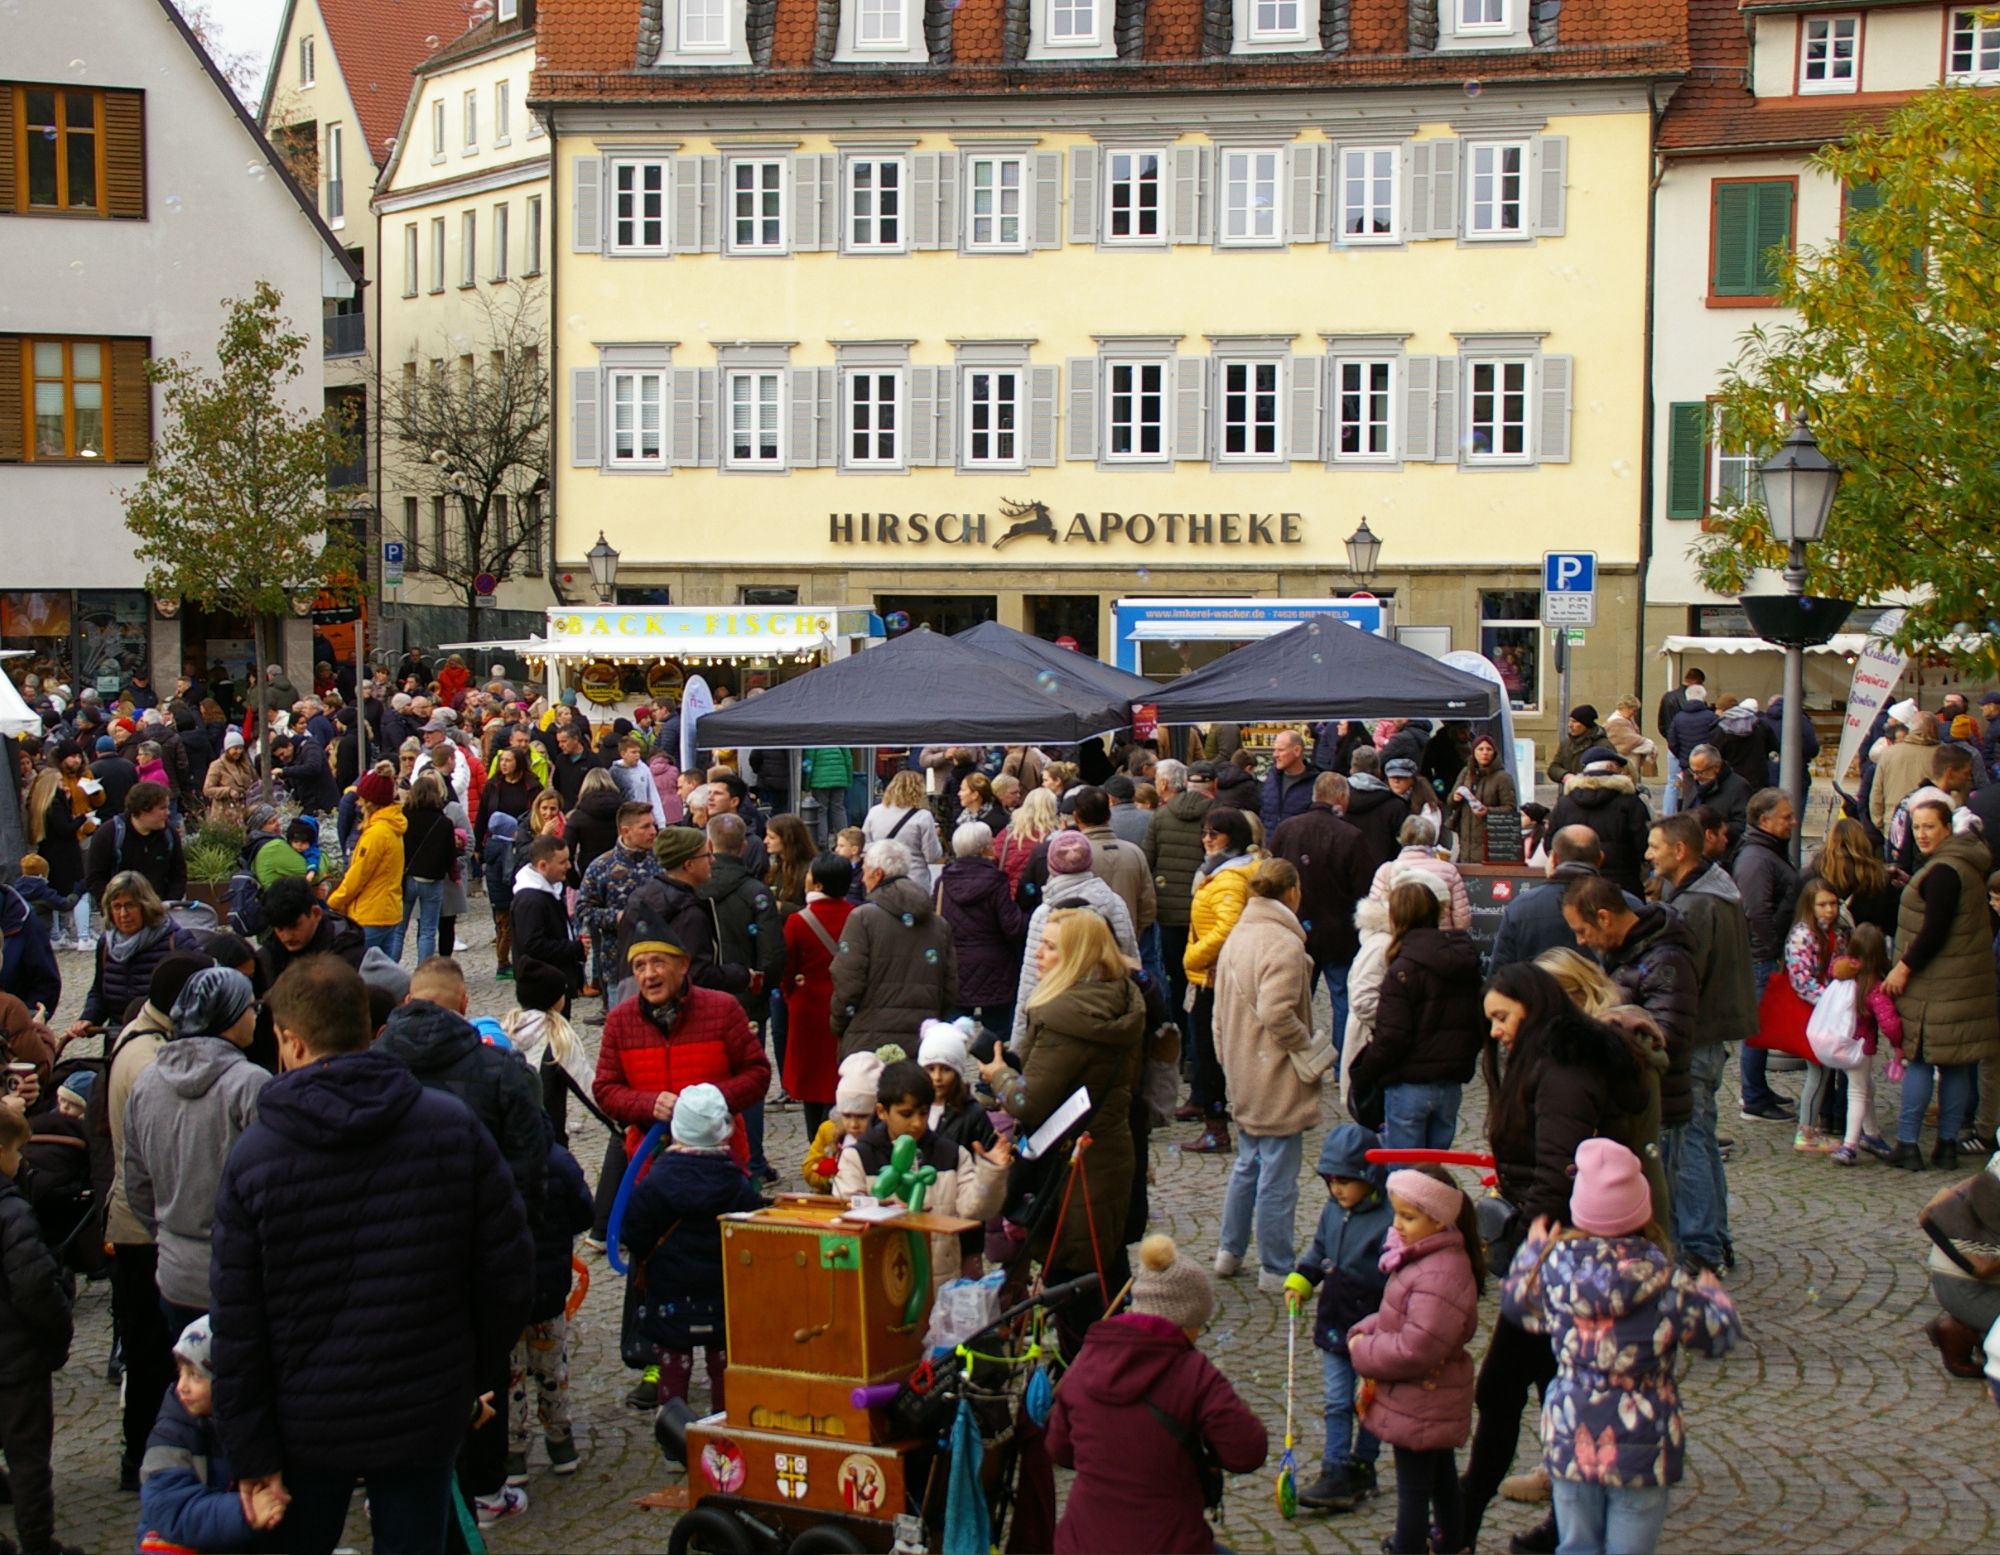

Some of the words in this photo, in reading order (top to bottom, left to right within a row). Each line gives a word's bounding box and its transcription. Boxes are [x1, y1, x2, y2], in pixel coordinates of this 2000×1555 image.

[829, 513, 986, 543] HIRSCH
[1064, 512, 1303, 543] APOTHEKE
[388, 545, 400, 560] P
[1558, 556, 1582, 589] P
[1145, 608, 1265, 619] www.imkerei-wacker.de
[568, 614, 666, 635] BACK
[704, 614, 816, 635] FISCH
[1846, 713, 1862, 727] Tee
